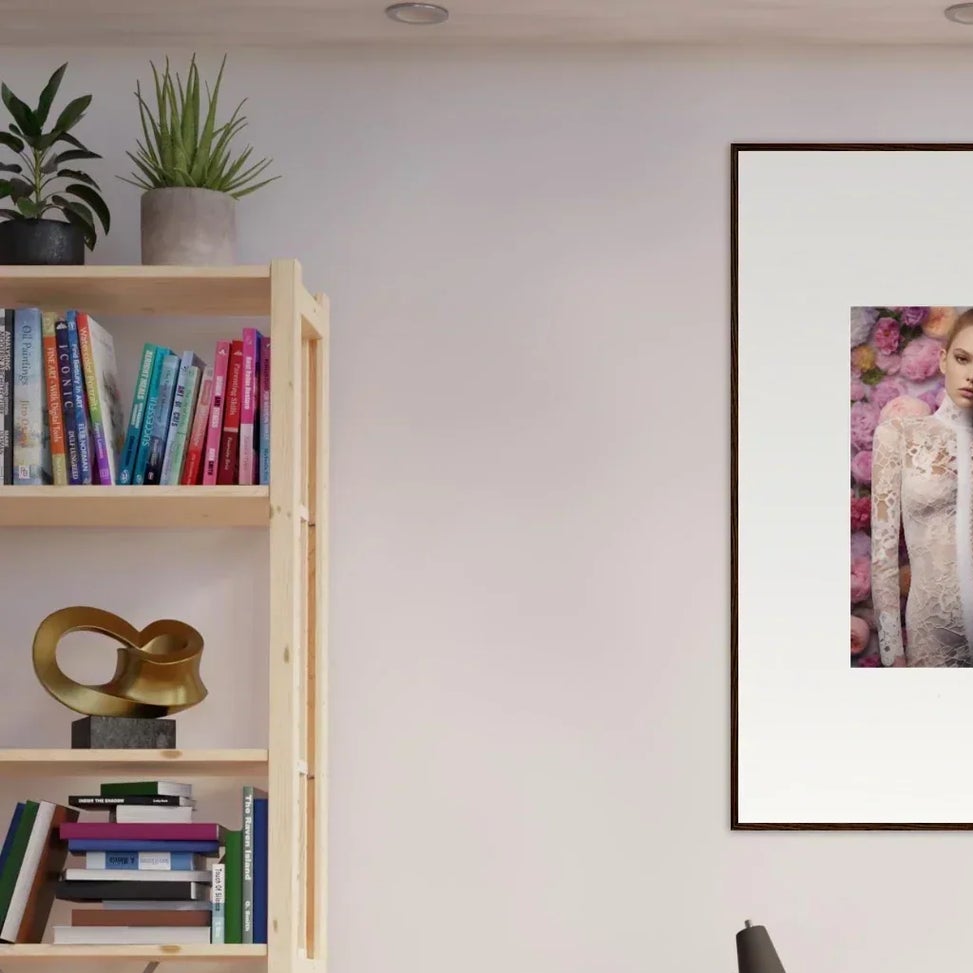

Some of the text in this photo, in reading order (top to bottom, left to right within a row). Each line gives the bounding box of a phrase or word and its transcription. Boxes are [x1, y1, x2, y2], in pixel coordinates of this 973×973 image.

[18, 325, 32, 386] Oil Paintings
[71, 343, 79, 358] Find
[48, 365, 57, 379] ART
[59, 344, 73, 408] ICONIC
[80, 326, 99, 412] Watercolor Portraits
[231, 363, 240, 396] Parenting
[49, 384, 59, 402] With
[52, 426, 62, 443] Tools
[79, 440, 89, 472] NORMAN
[215, 868, 223, 884] Touch
